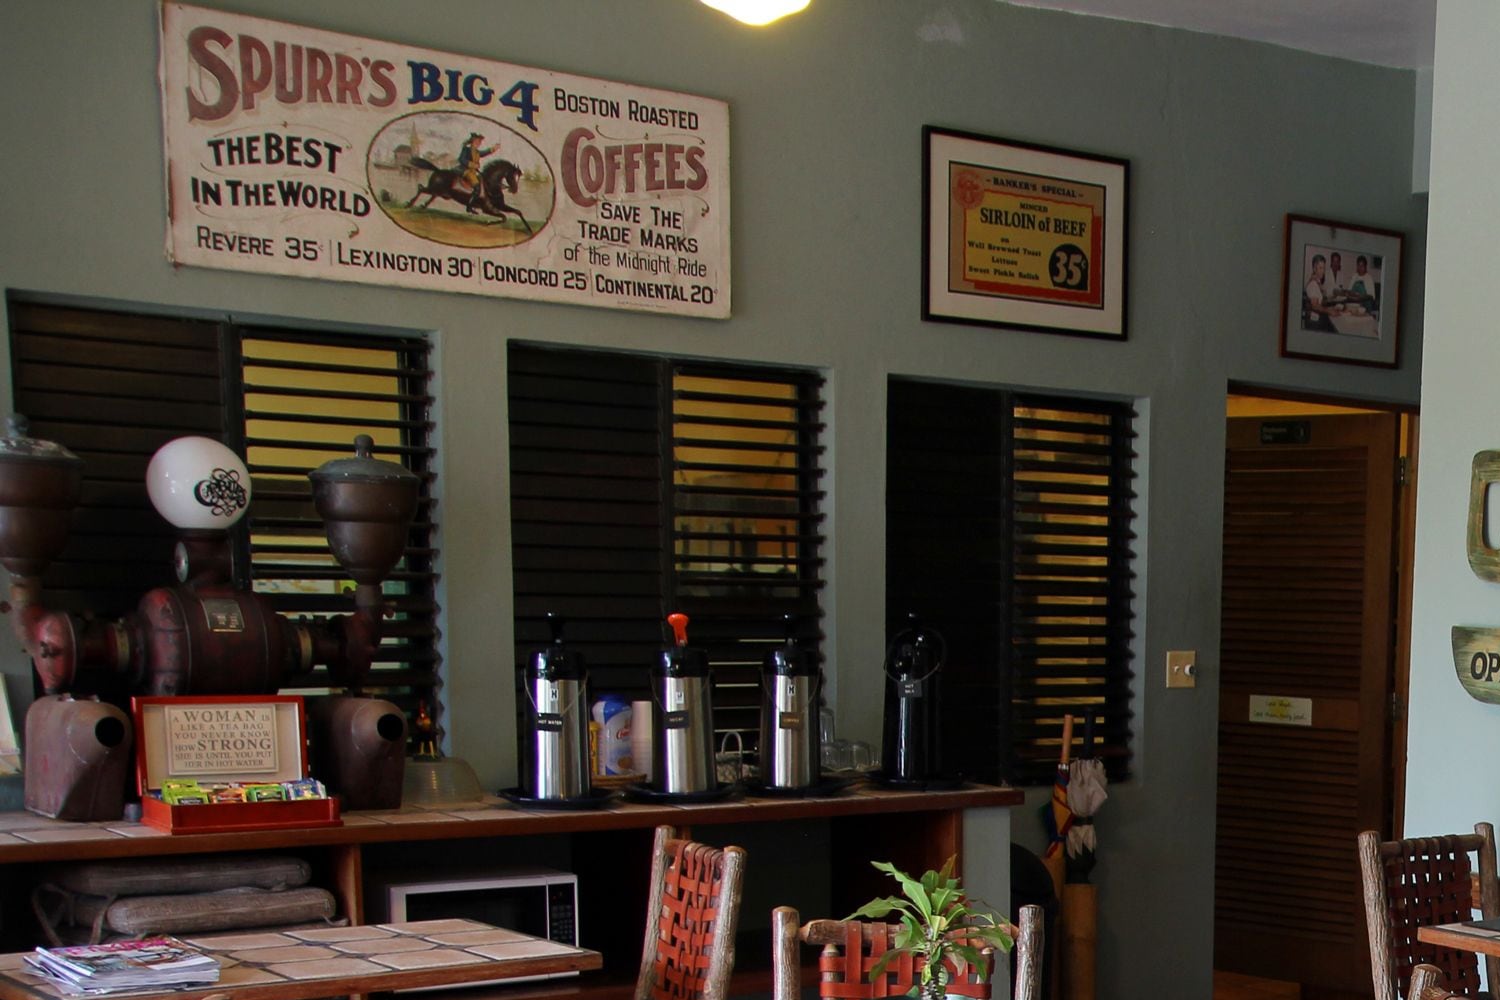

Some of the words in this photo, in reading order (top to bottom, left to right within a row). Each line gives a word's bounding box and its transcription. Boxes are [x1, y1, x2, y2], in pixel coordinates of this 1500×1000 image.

[185, 25, 397, 123] SPURR'S
[407, 60, 494, 106] BIG
[499, 80, 540, 132] 4
[554, 88, 620, 118] BOSTON
[628, 99, 699, 130] ROASTED
[207, 136, 261, 167] THE
[264, 132, 342, 174] BEST
[561, 127, 708, 208] COFFEES
[191, 176, 222, 206] IN
[225, 179, 276, 206] THE
[277, 180, 371, 217] WORLD
[993, 177, 1038, 192] BANKER'S
[1042, 184, 1077, 198] SPECIAL
[600, 202, 641, 224] SAVE
[651, 206, 682, 230] THE
[980, 207, 1036, 230] SIRLOIN
[1039, 217, 1051, 233] of
[1053, 218, 1087, 237] BEEF
[197, 226, 275, 256] REVERE
[577, 220, 630, 245] TRADE
[640, 229, 698, 253] MARKS
[337, 241, 443, 275] LEXINGTON
[564, 243, 582, 262] of
[589, 246, 610, 267] the
[617, 252, 671, 275] Midnight
[678, 257, 707, 278] Ride
[483, 261, 558, 288] CONCORD
[595, 274, 688, 302] CONTINENTAL
[184, 710, 256, 722] WOMAN
[175, 744, 197, 752] HOW
[198, 739, 271, 751] STRONG
[201, 731, 236, 739] NEVER
[240, 730, 271, 738] KNOW
[235, 751, 254, 759] YOU
[236, 759, 264, 767] WATER
